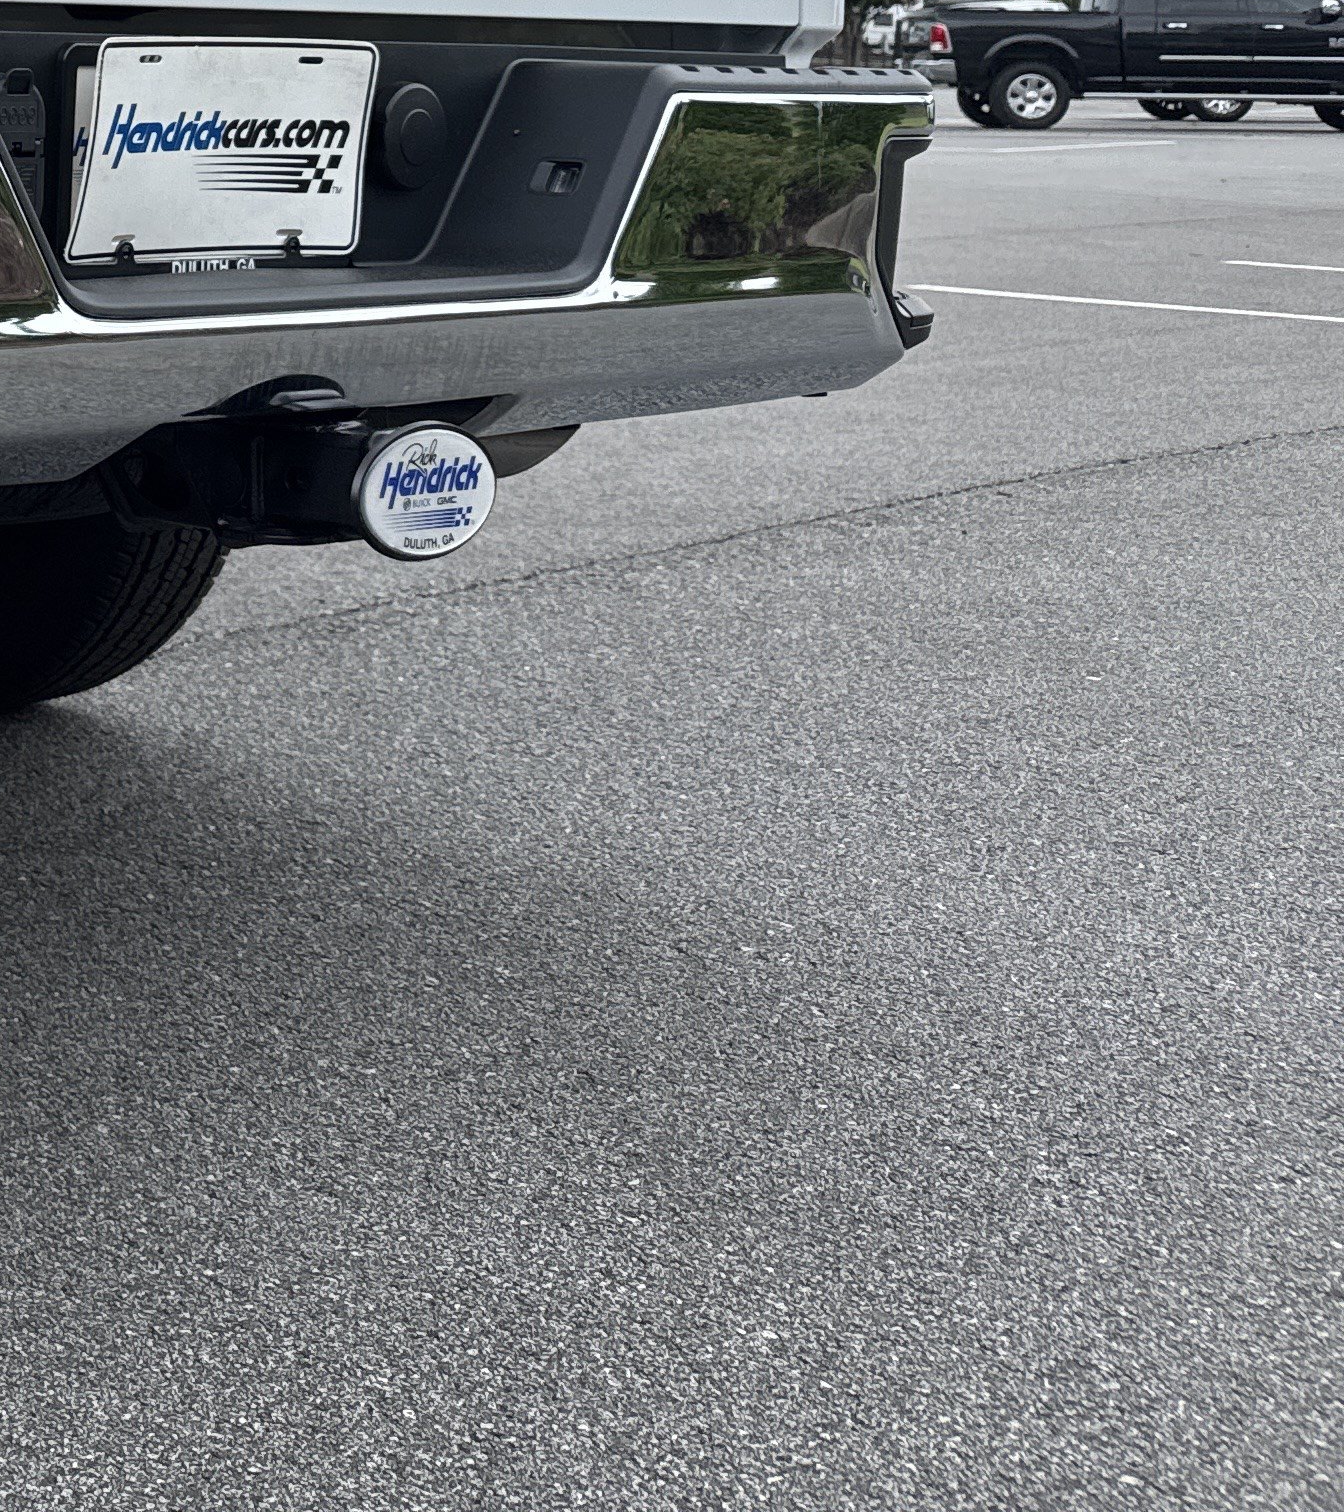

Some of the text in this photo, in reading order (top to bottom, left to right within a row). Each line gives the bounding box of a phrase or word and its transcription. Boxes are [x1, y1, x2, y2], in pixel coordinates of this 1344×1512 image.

[102, 103, 351, 170] Hendrickcars.com
[401, 438, 439, 474] Rick
[379, 455, 483, 510] Hendrick
[436, 495, 458, 506] GMC
[441, 532, 455, 546] GA
